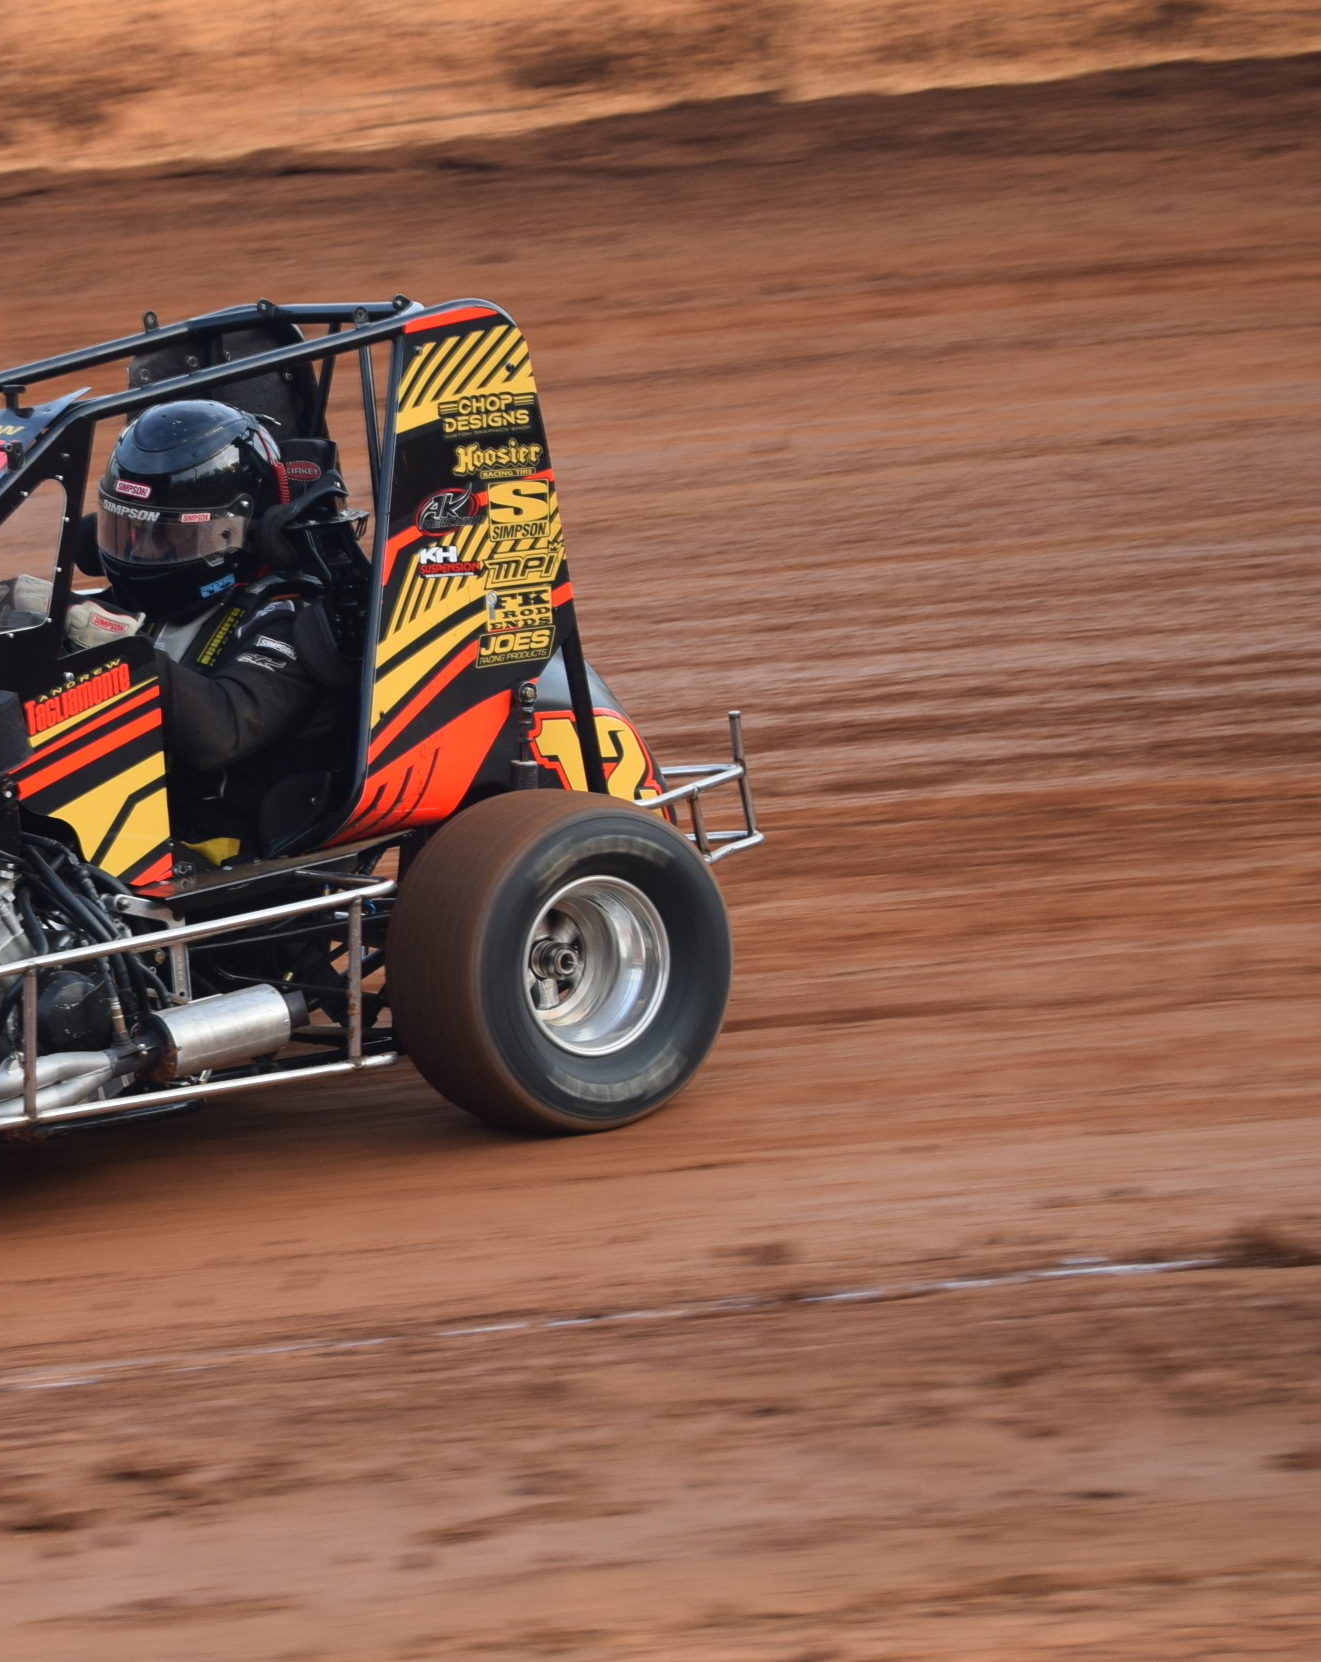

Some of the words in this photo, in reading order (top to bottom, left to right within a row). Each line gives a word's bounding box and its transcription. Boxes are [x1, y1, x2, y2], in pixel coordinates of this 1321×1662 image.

[459, 394, 513, 415] CHOP
[444, 410, 530, 432] DESIGNS
[453, 438, 542, 474] Hoosier
[117, 483, 147, 496] SIMPSON
[103, 499, 160, 522] SIMPSON
[183, 514, 209, 522] SIMPSON
[492, 523, 545, 539] SIMPSON
[420, 546, 457, 564] KH
[420, 562, 479, 574] SUSPENSION
[493, 589, 549, 609] FK
[502, 607, 551, 618] ROD
[489, 616, 551, 630] ENDS
[480, 629, 551, 656] JOES
[480, 653, 506, 665] RACING
[506, 648, 547, 661] PRODUCTS
[37, 659, 121, 703] ANDREW
[534, 715, 664, 818] 12
